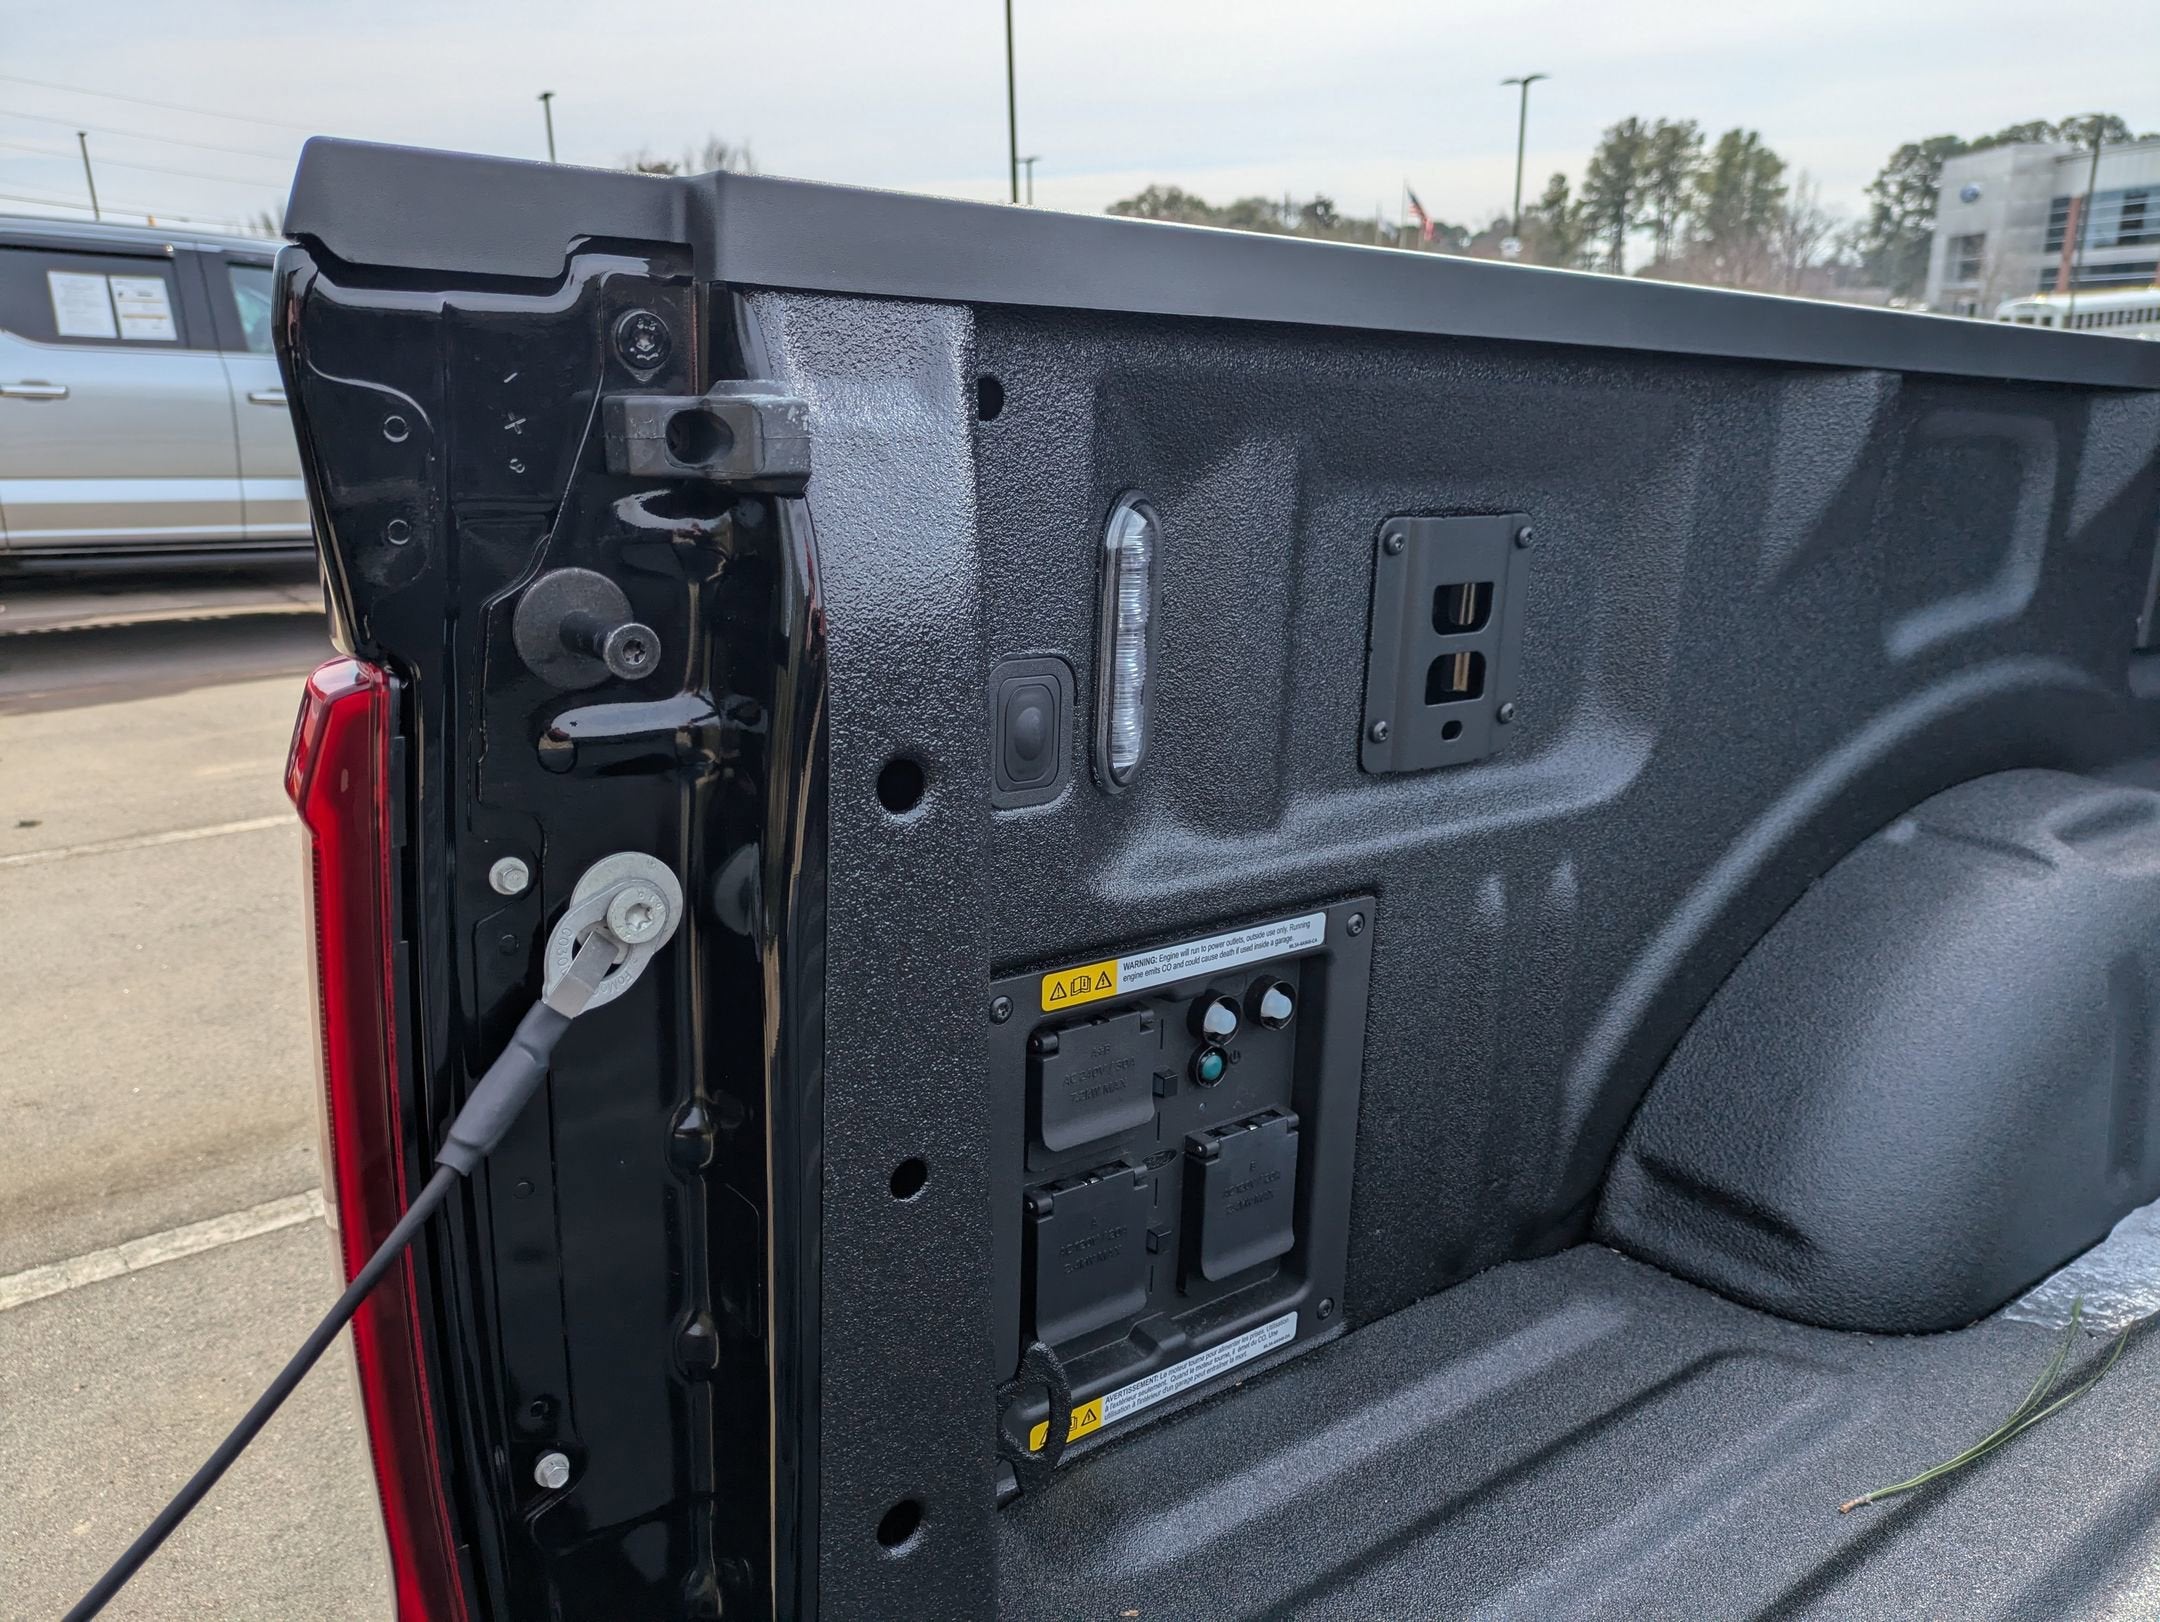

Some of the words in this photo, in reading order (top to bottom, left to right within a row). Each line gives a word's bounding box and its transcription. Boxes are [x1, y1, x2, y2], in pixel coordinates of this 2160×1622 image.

[1123, 956, 1157, 971] WARNING:
[1159, 952, 1179, 962] Engine
[1180, 948, 1190, 957] will
[1190, 947, 1200, 955] run
[1207, 942, 1225, 952] power
[1226, 937, 1245, 947] outlets,
[1246, 931, 1265, 942] outside
[1266, 929, 1276, 937] use
[1289, 921, 1311, 931] Running
[1123, 971, 1143, 982] engine
[1145, 967, 1161, 977] emits
[1161, 963, 1172, 973] CO
[1173, 960, 1184, 970] and
[1185, 956, 1200, 967] could
[1201, 953, 1218, 963] cause
[1219, 949, 1235, 958] death
[1236, 946, 1240, 954] if
[1240, 943, 1253, 954] used
[1254, 941, 1269, 950] inside
[1104, 1404, 1131, 1420] utilisation
[1137, 1390, 1161, 1405] l'intérieur
[1162, 1385, 1174, 1394] d'un
[1175, 1376, 1193, 1390] garage
[1194, 1369, 1206, 1381] peut
[1206, 1360, 1229, 1374] entraîner
[1105, 1375, 1158, 1404] AVERTISSEMENT:
[1160, 1372, 1167, 1380] Le
[1168, 1363, 1188, 1376] moteur
[1188, 1356, 1205, 1367] tourne
[1205, 1350, 1217, 1361] pour
[1218, 1339, 1241, 1354] alimenter
[1266, 1318, 1289, 1332] Utilisation
[1110, 1393, 1137, 1410] l'extérieur
[1170, 1369, 1189, 1382] Quand
[1195, 1359, 1213, 1371] moteur
[1237, 1342, 1250, 1353] émet
[1250, 1339, 1257, 1347] du
[1268, 1330, 1279, 1338] Une
